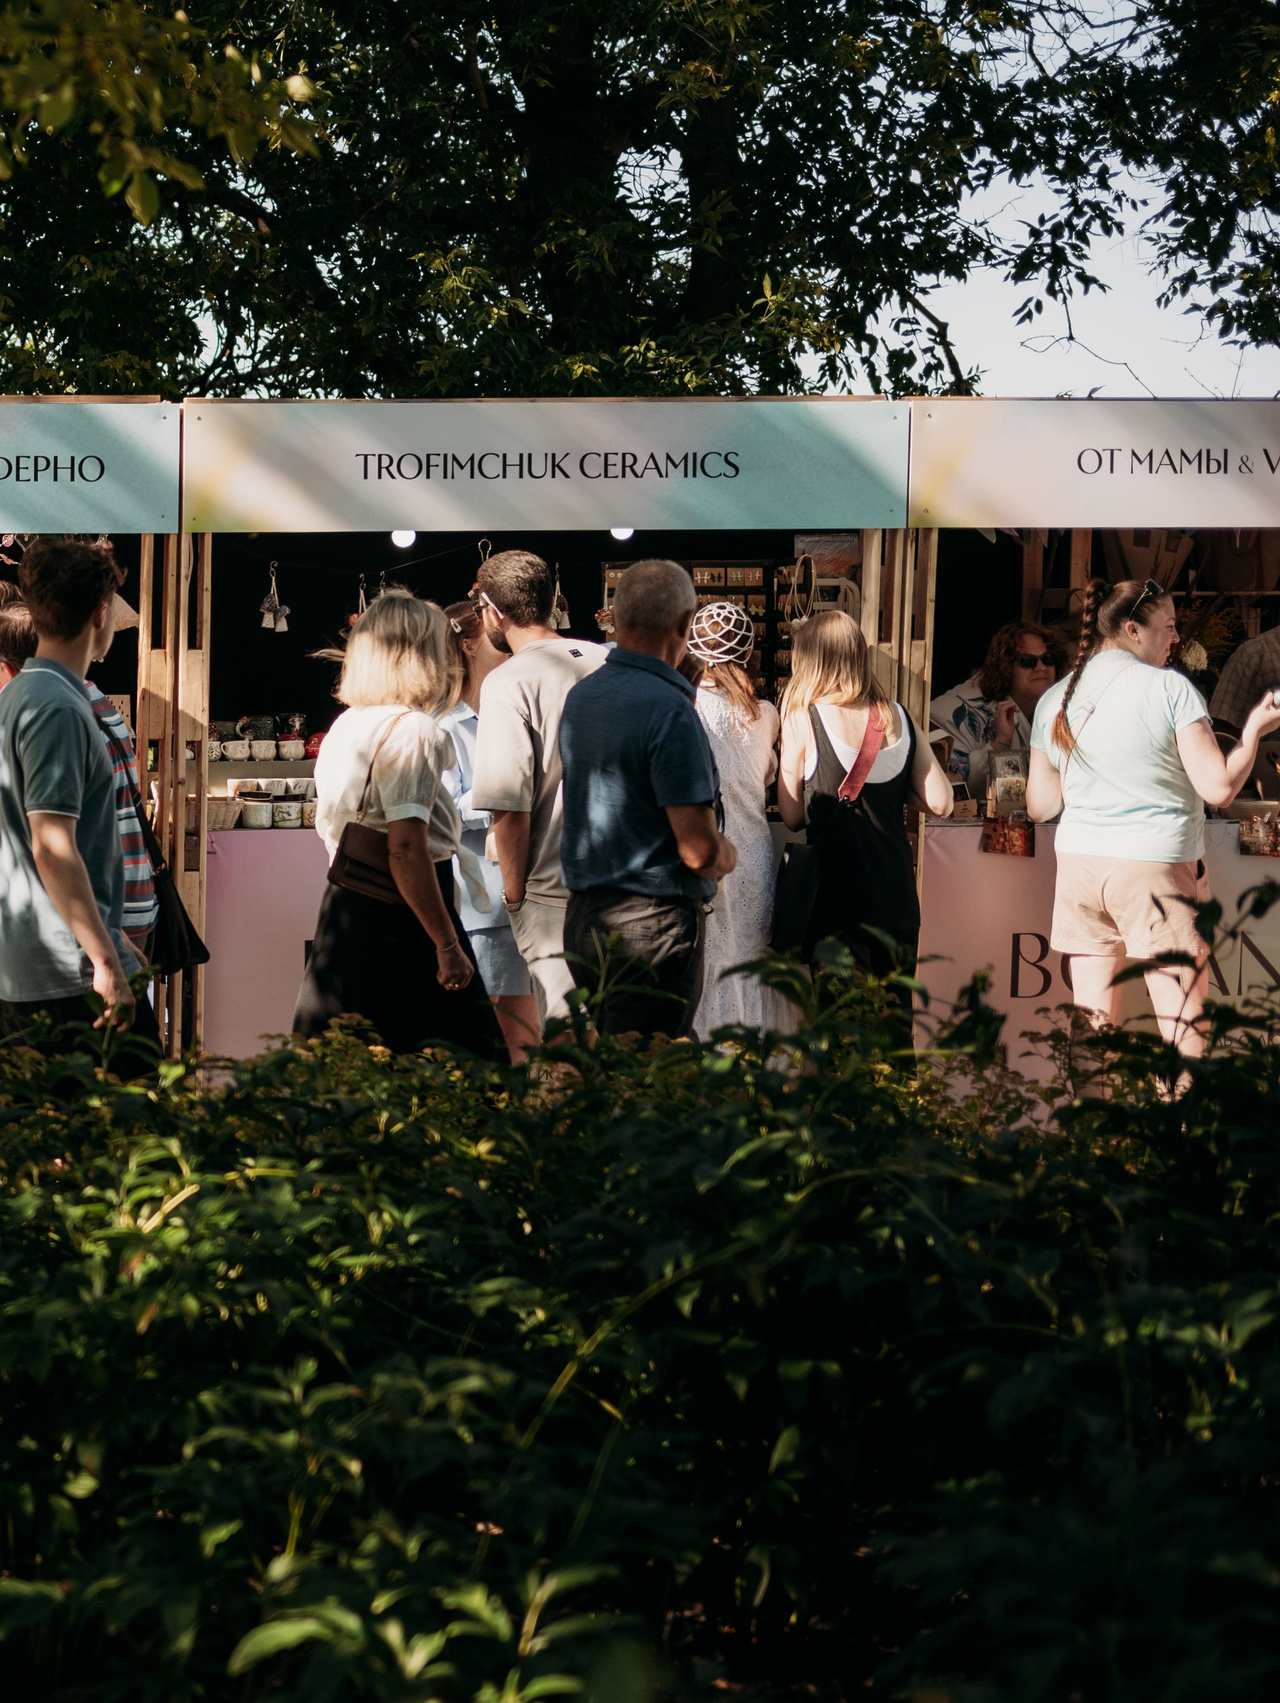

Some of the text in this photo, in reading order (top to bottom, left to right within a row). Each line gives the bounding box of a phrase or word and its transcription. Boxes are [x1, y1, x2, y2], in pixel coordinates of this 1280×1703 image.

[354, 451, 741, 481] TROFIMCHUK CERAMICS
[1076, 448, 1122, 475] ОТ
[1130, 448, 1229, 475] МАМЫ
[1238, 454, 1254, 475] &
